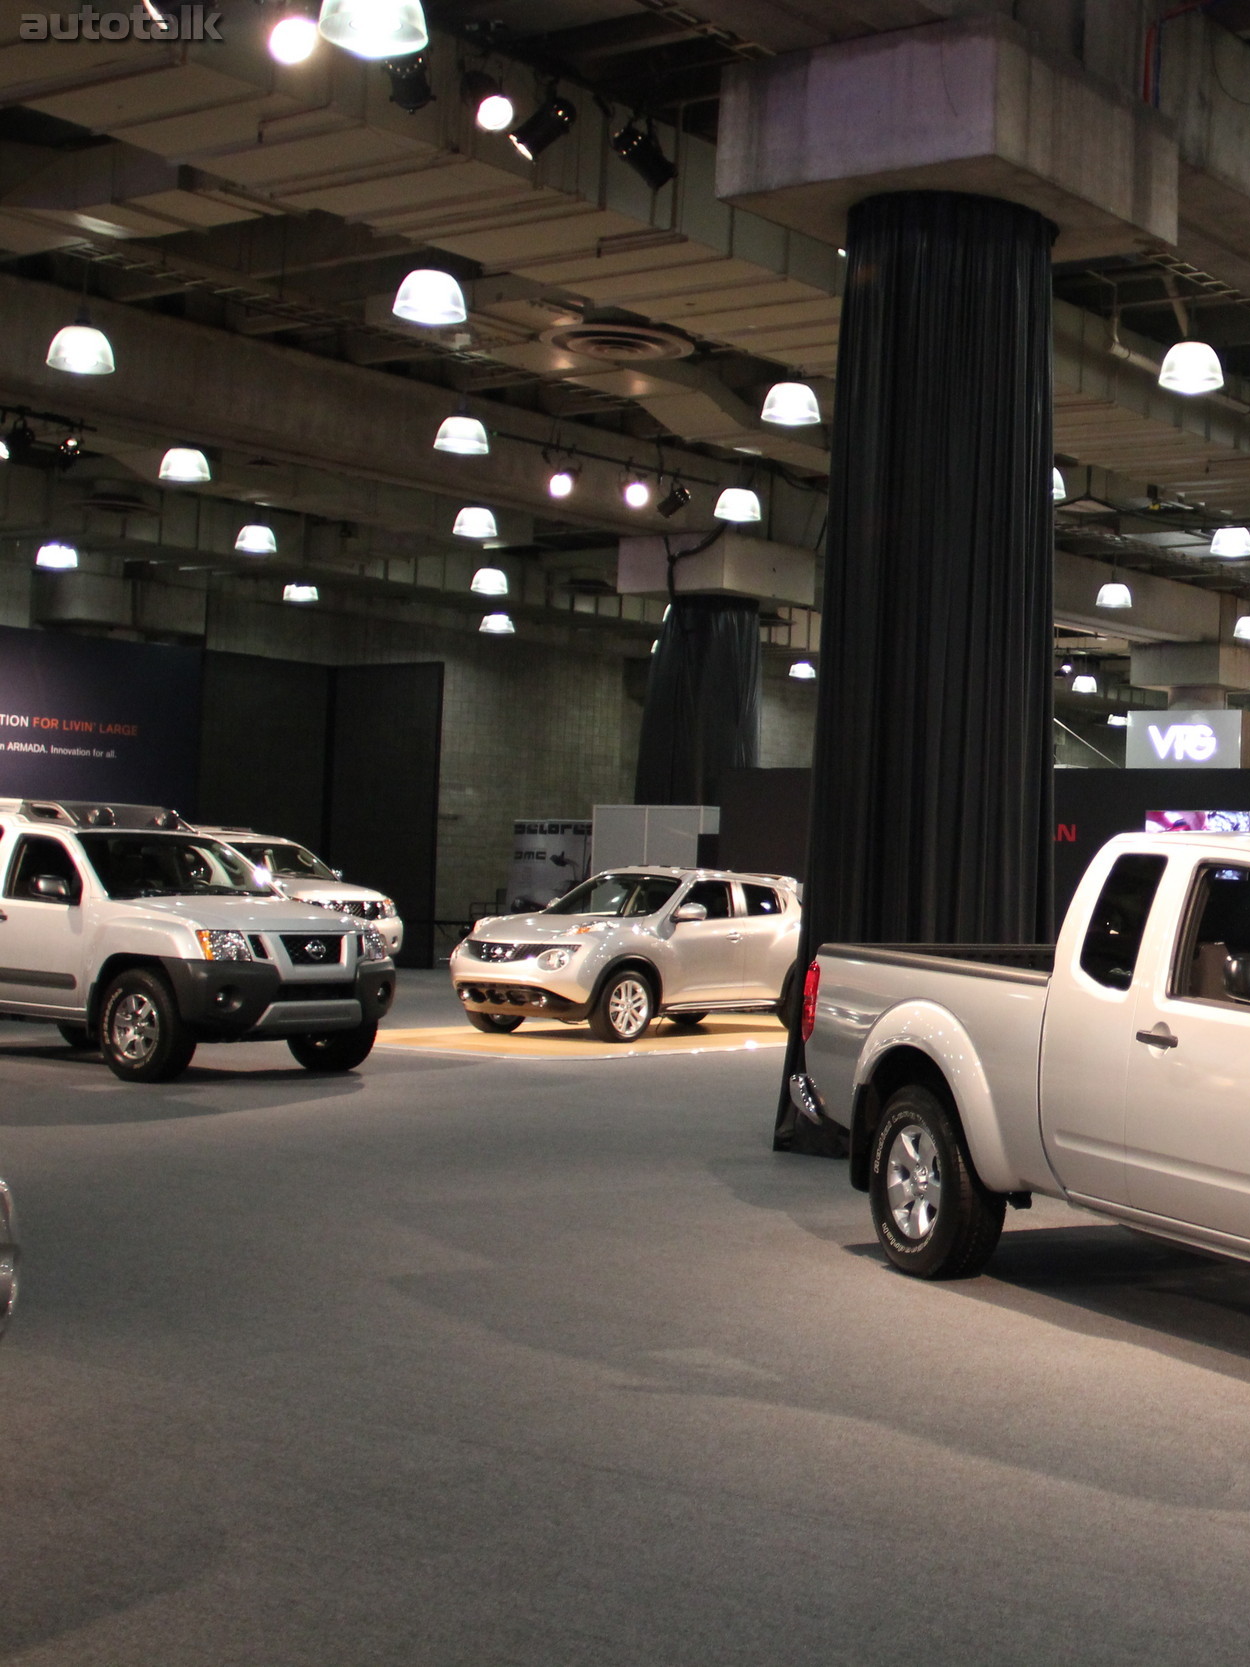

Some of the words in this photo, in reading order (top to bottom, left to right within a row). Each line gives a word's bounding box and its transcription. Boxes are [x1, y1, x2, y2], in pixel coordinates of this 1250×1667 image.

[33, 716, 59, 730] FOR
[63, 719, 96, 732] LIVIN'
[99, 723, 138, 736] LARGE
[7, 742, 48, 754] ARMADA.
[51, 745, 91, 758] Innovation
[93, 749, 104, 758] for
[105, 750, 117, 759] all.
